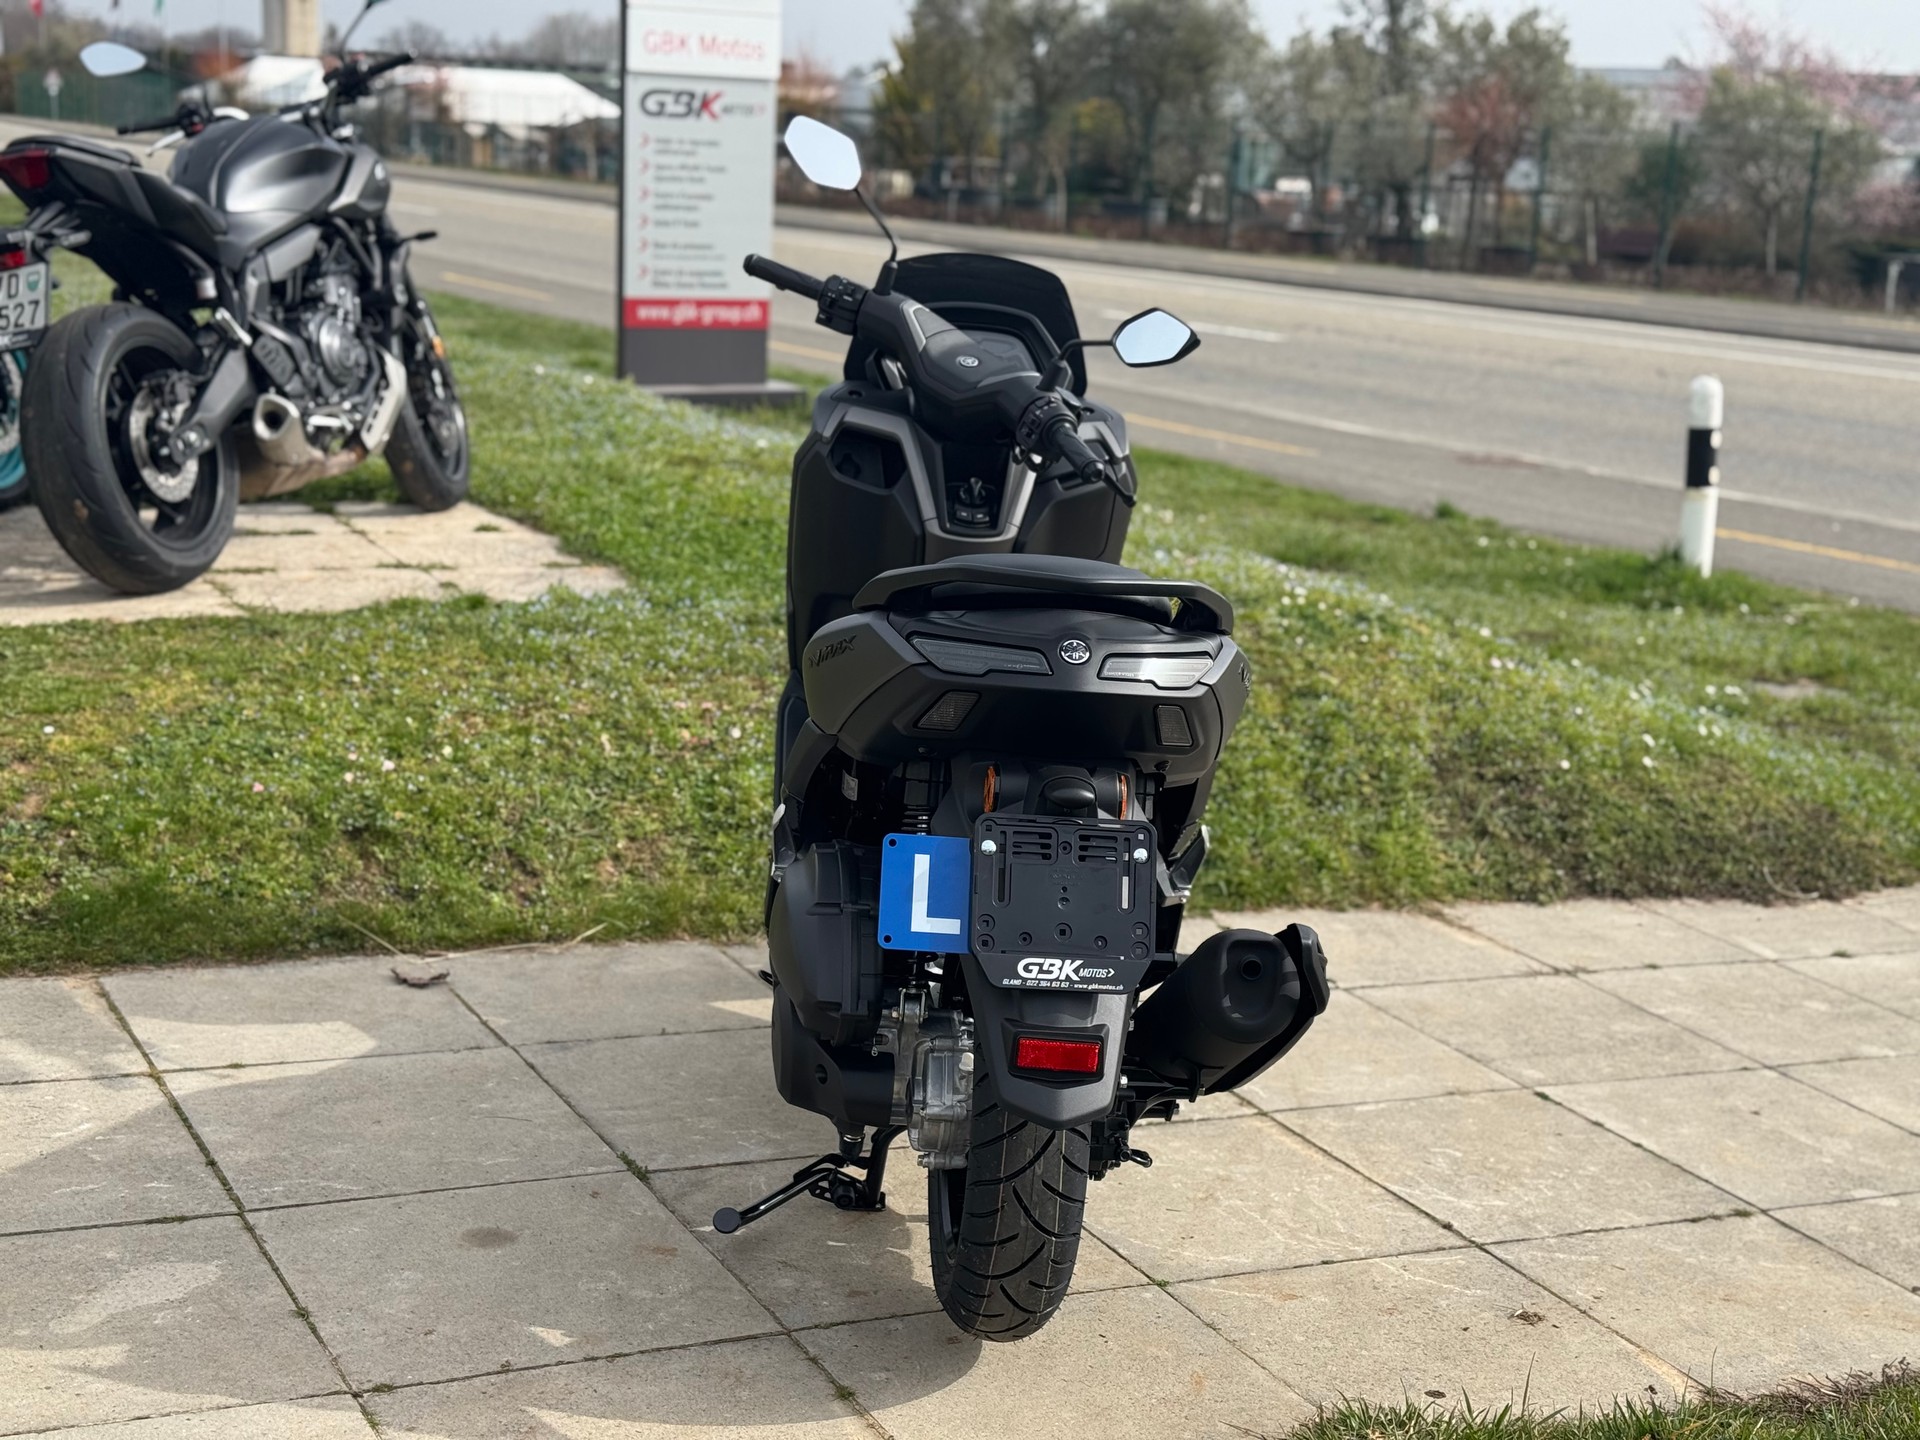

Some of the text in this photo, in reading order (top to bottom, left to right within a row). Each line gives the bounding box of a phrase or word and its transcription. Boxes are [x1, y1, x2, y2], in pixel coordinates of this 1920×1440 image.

[643, 29, 766, 61] GBK Motos
[640, 88, 725, 120] GBK
[0, 300, 39, 331] 527
[911, 853, 961, 934] L
[1002, 978, 1022, 986] GLAND
[1026, 979, 1039, 987] 022
[1017, 957, 1108, 981] GBK MOTOS
